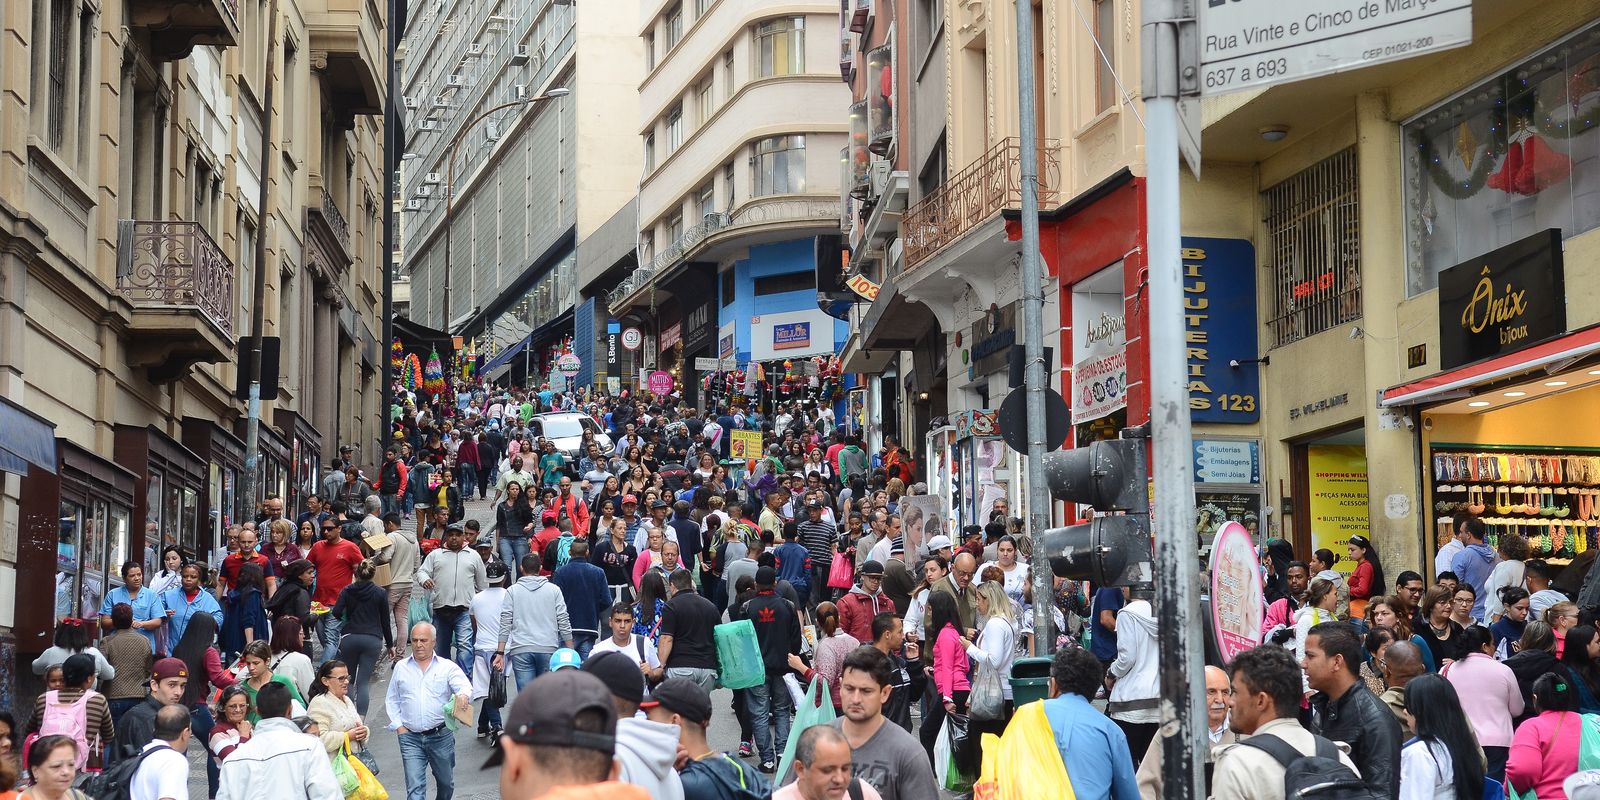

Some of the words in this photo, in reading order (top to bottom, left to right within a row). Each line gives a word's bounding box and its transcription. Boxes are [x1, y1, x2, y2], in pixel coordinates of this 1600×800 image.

[1206, 35, 1237, 52] Rua
[1243, 24, 1284, 45] Vinte
[1289, 22, 1299, 36] e
[1305, 9, 1353, 32] Cinco
[1359, 1, 1379, 20] de
[1386, 0, 1438, 13] Març
[1362, 48, 1382, 60] CEP
[1385, 37, 1433, 55] 01021-200
[1206, 68, 1235, 88] 637
[1241, 69, 1250, 81] a
[1257, 58, 1287, 78] 693
[852, 276, 880, 299] 103
[1461, 265, 1527, 333] Ônix
[1181, 247, 1213, 410] BIJUTERIAS
[608, 334, 616, 364] S.Bento
[1218, 394, 1256, 412] 123
[1210, 446, 1240, 454] Bijuterias
[1211, 458, 1249, 466] Embalagens
[1321, 492, 1339, 500] PEÇAS
